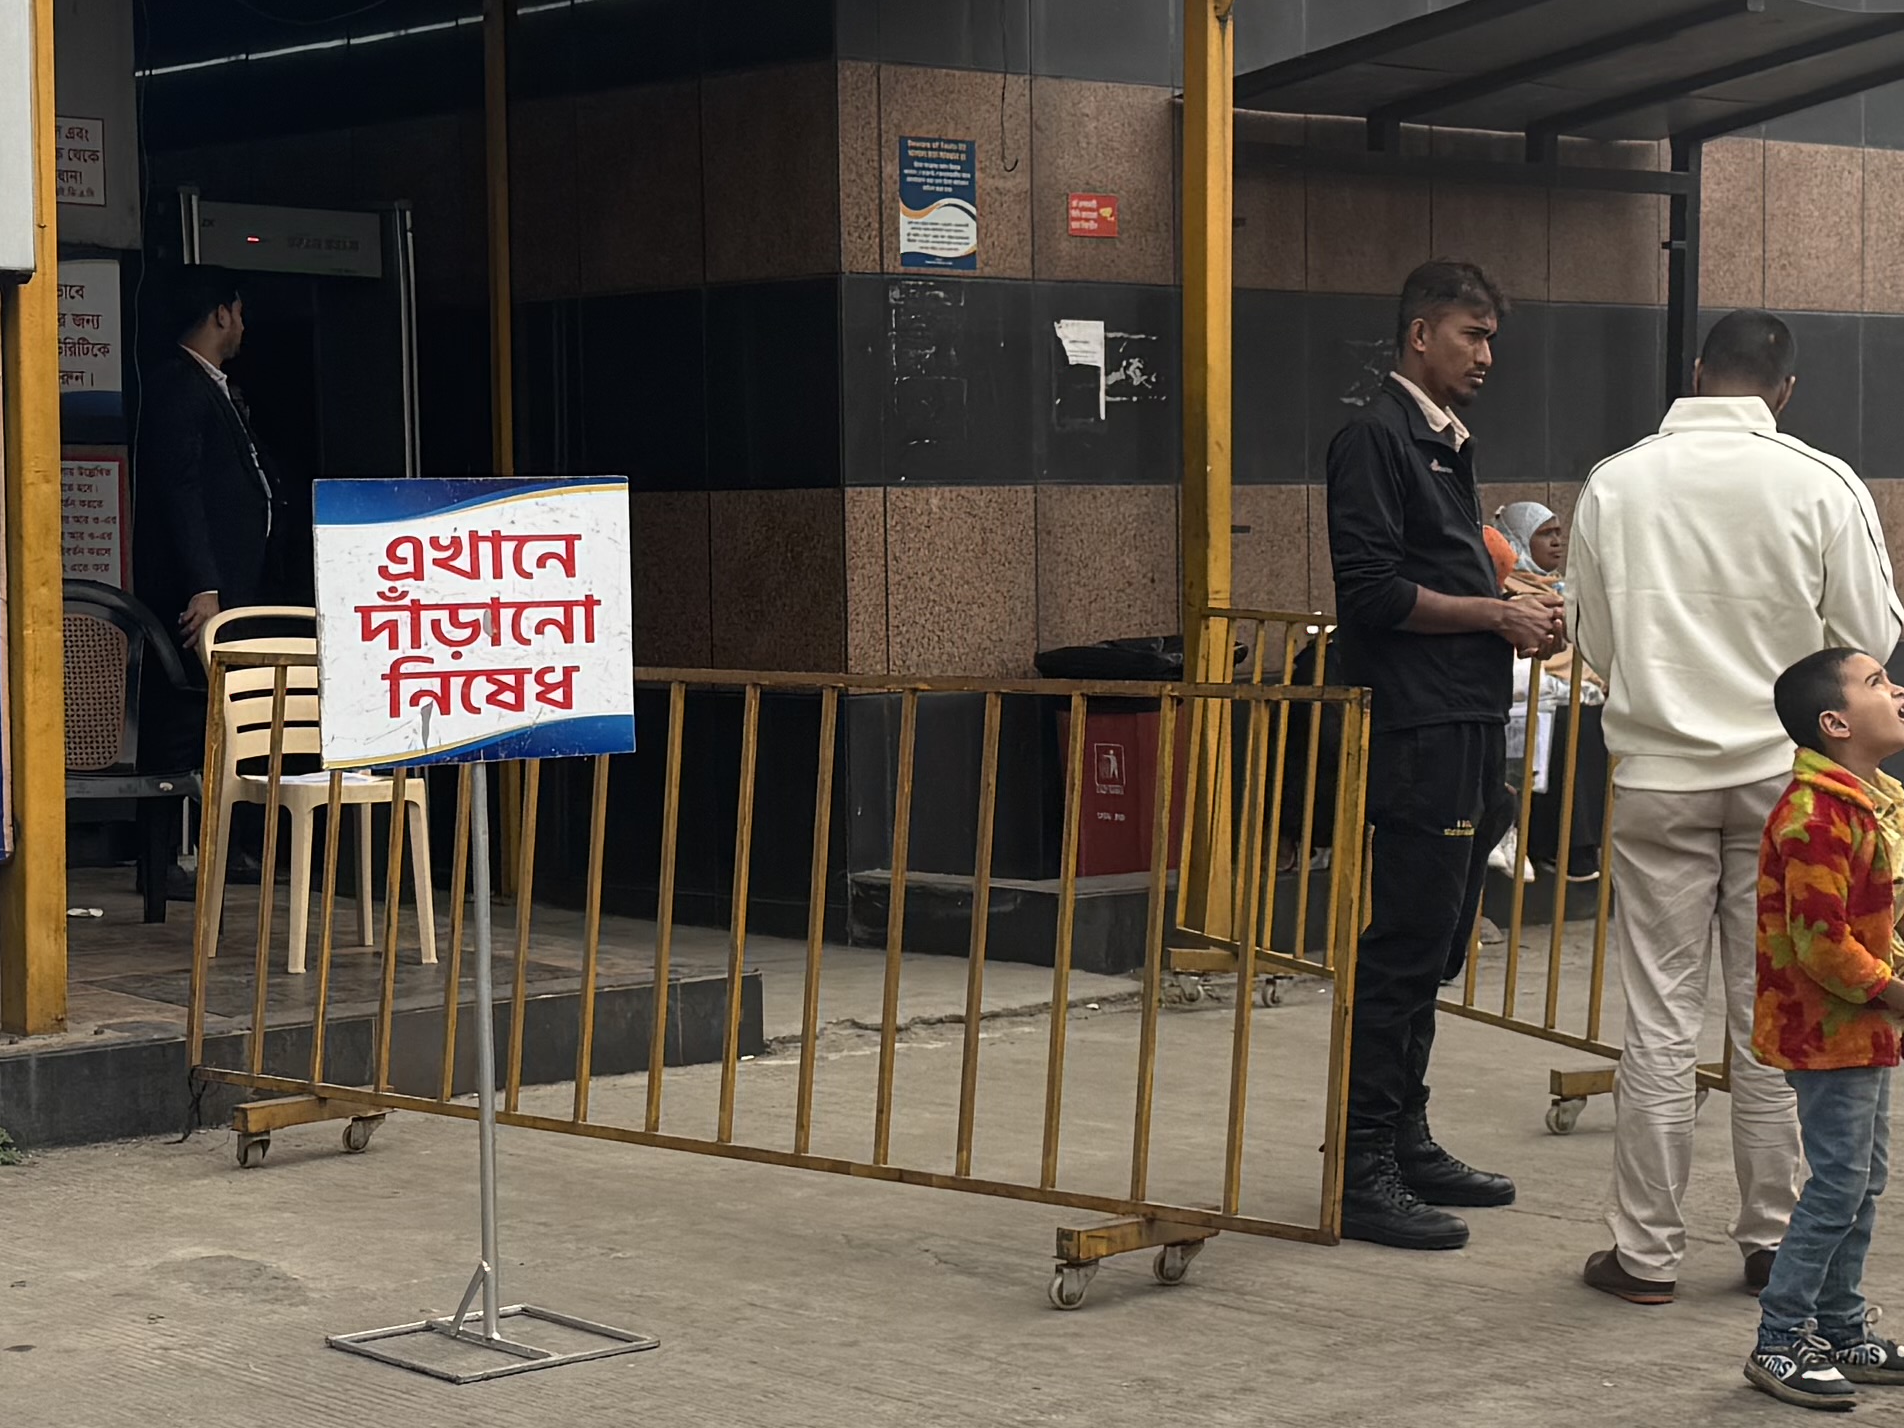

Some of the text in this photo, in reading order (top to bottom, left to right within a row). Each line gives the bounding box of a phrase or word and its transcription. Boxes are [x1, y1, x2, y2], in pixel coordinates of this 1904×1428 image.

[68, 148, 100, 163] থেকে
[71, 313, 102, 330] জন্য
[377, 530, 582, 581] এখানে
[354, 585, 602, 660] দাঁড়ানো
[380, 655, 580, 718] নিষেধ
